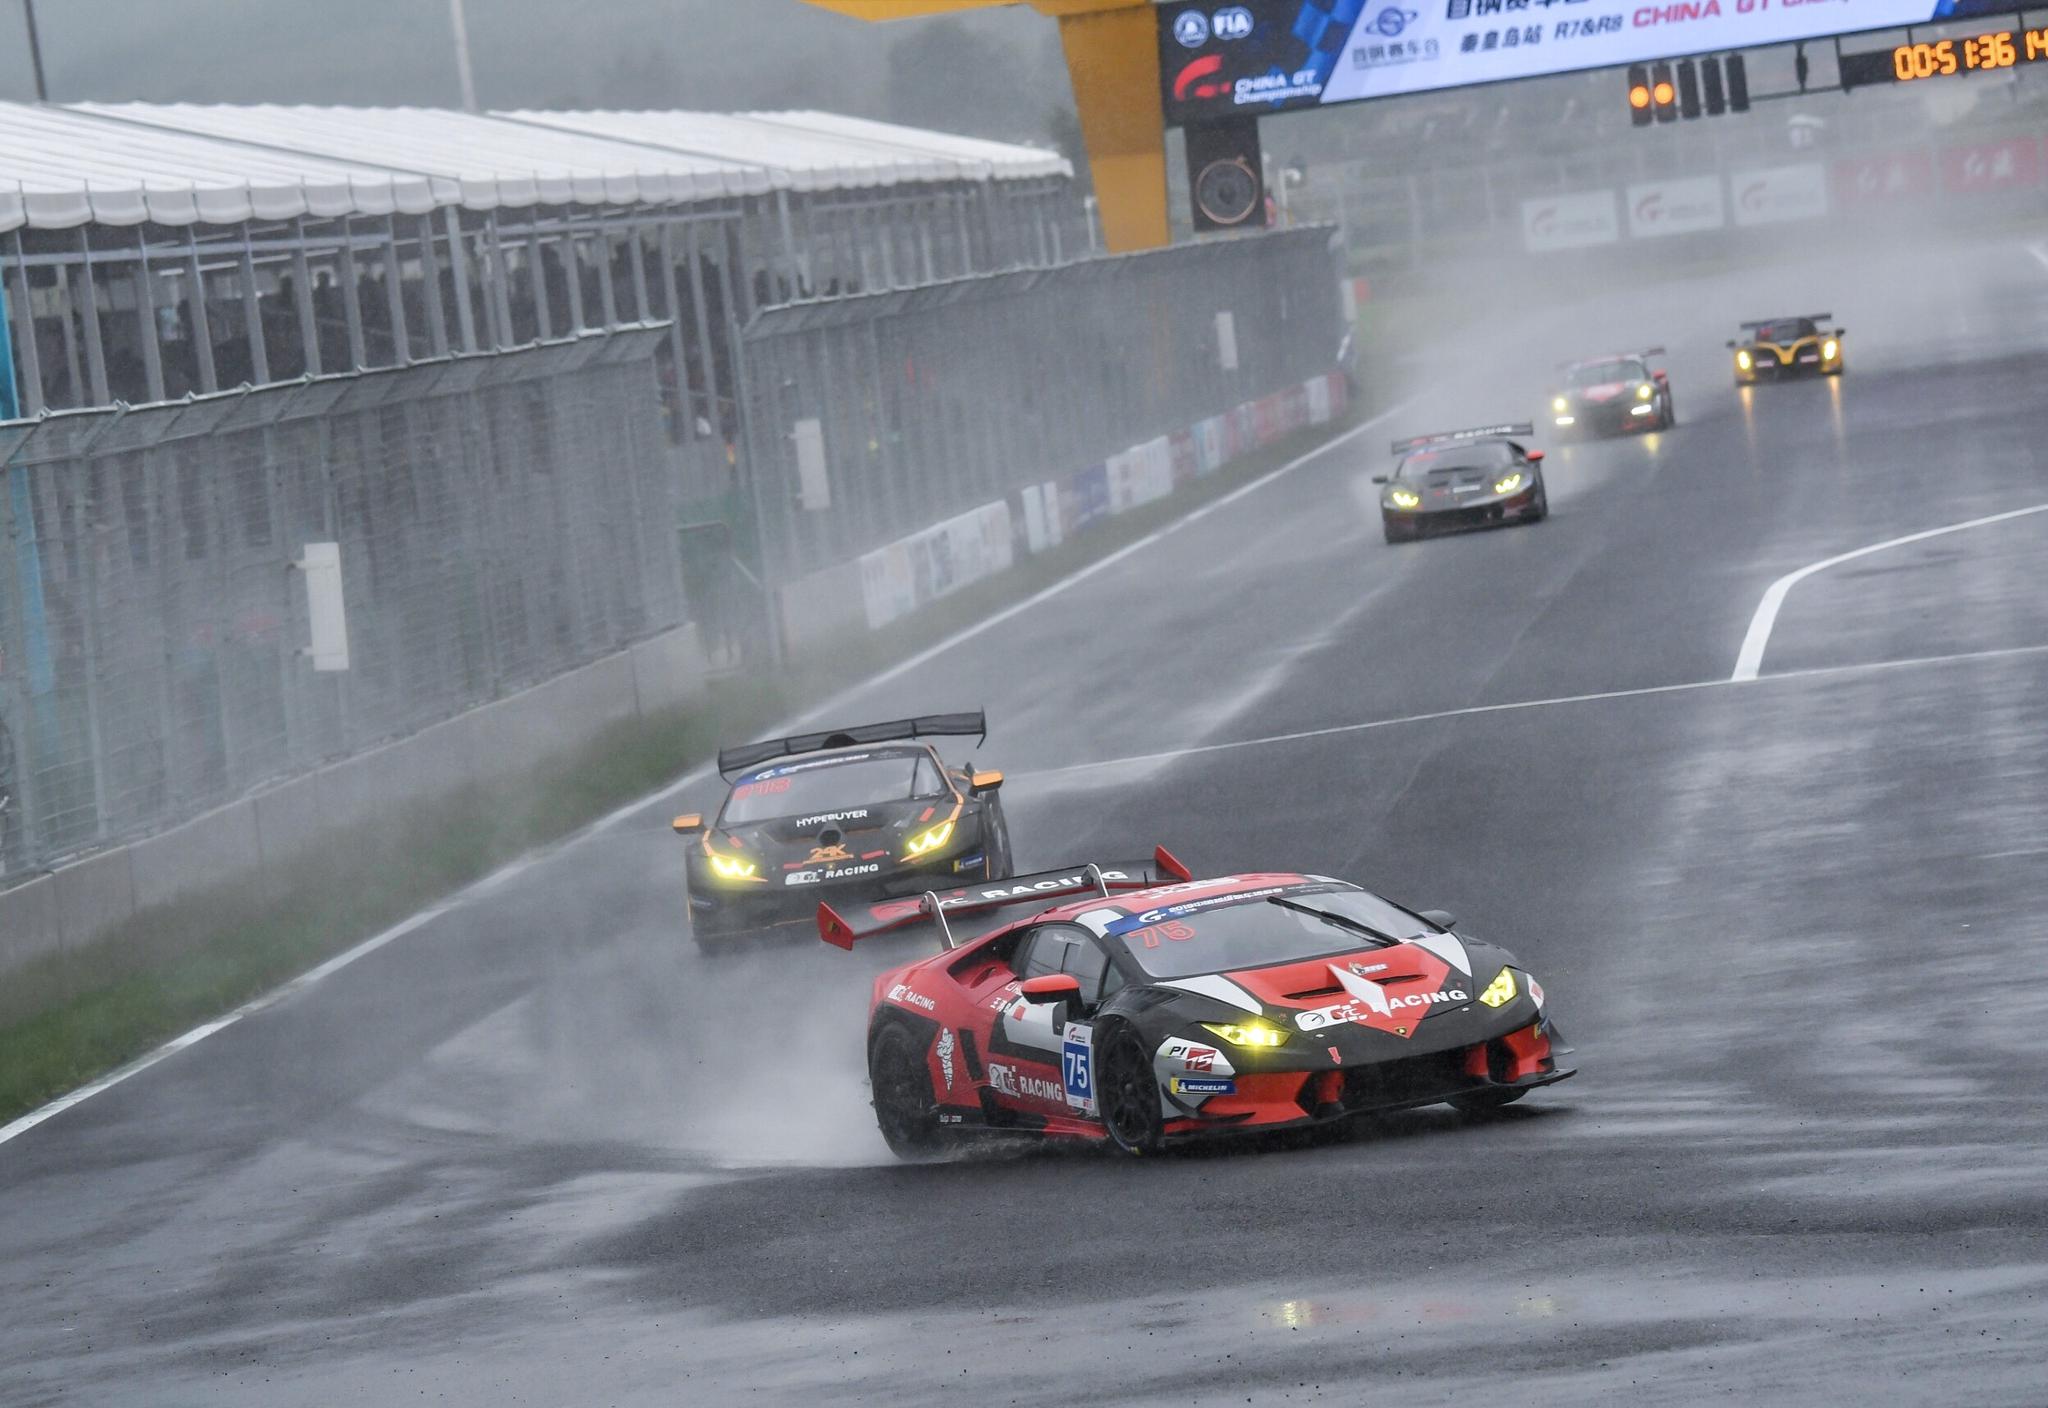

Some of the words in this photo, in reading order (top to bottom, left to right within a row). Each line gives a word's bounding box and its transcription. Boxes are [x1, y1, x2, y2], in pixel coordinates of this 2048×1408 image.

[1213, 13, 1247, 35] FIA
[1555, 14, 1623, 40] R7&R8
[1633, 0, 1721, 27] CHINA
[1235, 73, 1287, 92] CHINA
[1293, 69, 1316, 85] GT
[796, 810, 868, 827] HYPEBUYER
[825, 864, 879, 878] RACING
[1129, 921, 1195, 949] 75
[905, 991, 936, 1010] RACING
[1065, 1051, 1088, 1089] 75
[1020, 1076, 1064, 1101] RACING
